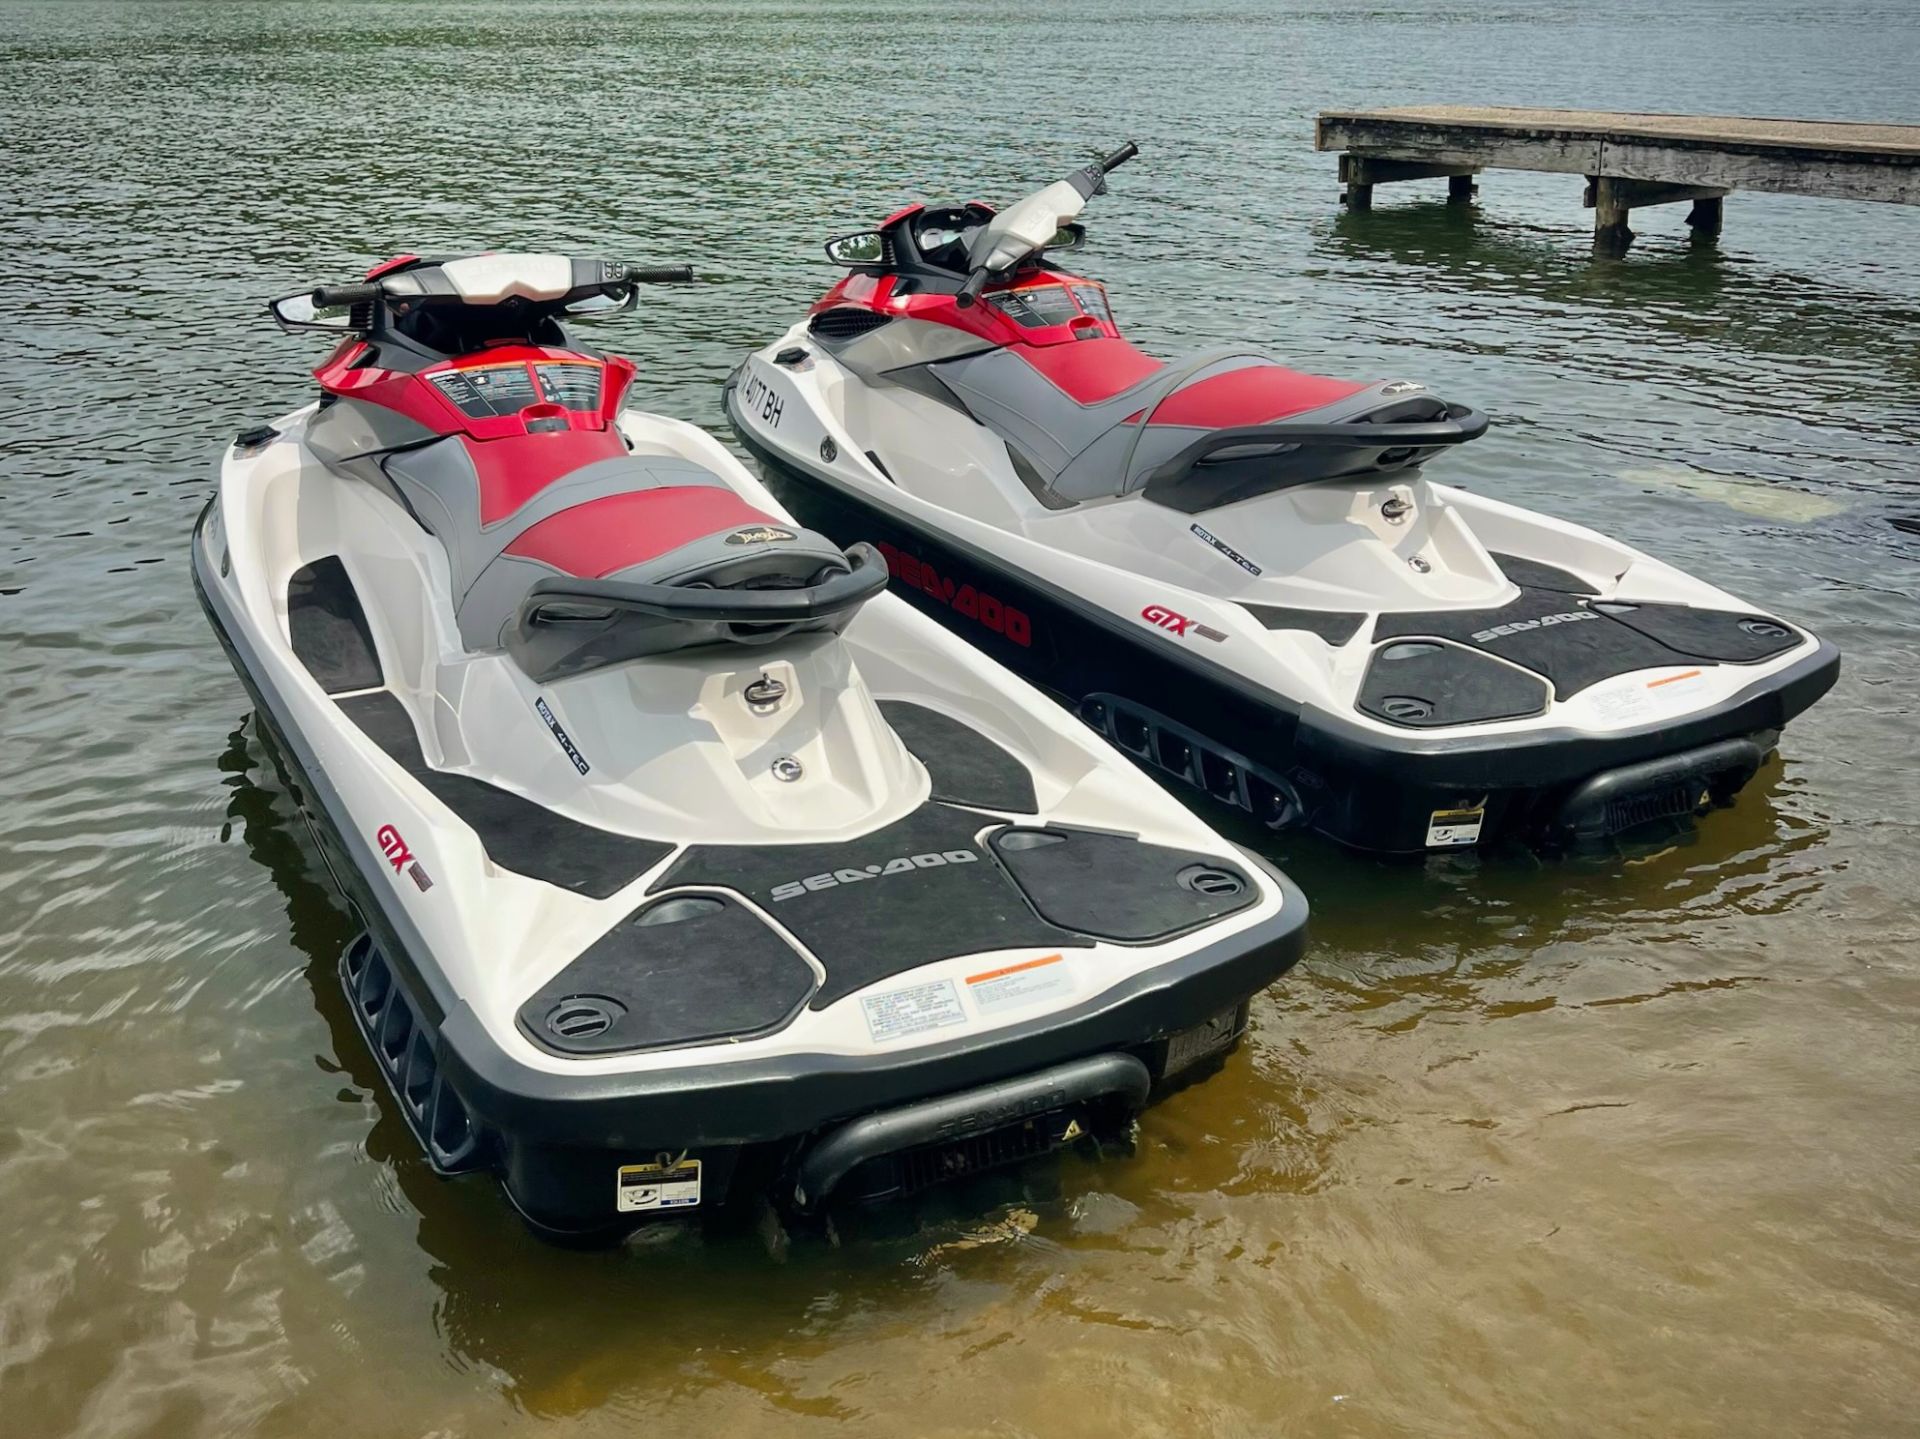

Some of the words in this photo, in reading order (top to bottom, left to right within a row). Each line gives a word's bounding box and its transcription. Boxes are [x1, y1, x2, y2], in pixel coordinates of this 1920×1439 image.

[762, 389, 784, 429] BH
[1141, 604, 1199, 638] GTX
[377, 824, 416, 876] GTX
